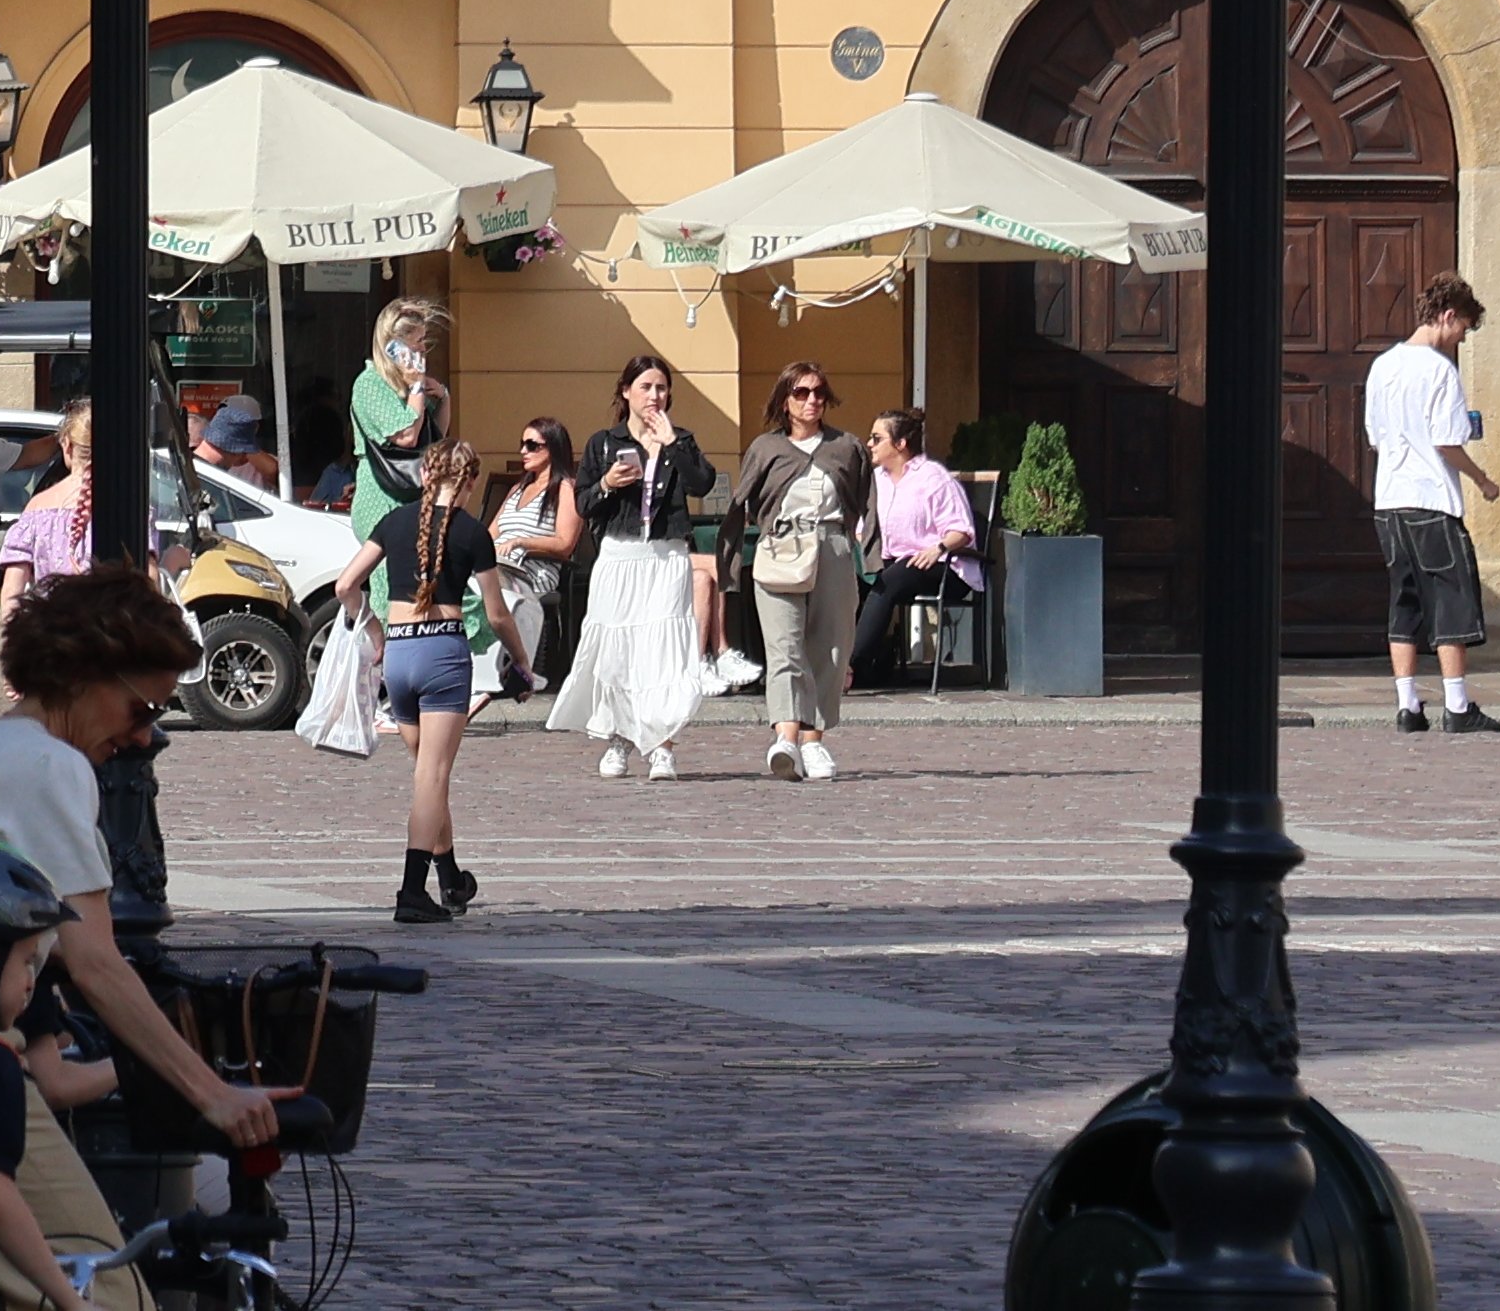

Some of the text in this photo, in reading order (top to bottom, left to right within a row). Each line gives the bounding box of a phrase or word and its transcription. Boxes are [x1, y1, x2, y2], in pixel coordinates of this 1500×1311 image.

[150, 230, 213, 257] eken
[285, 211, 438, 248] BULL PUB
[1143, 227, 1207, 257] BULL PUB
[386, 621, 457, 638] NIKE NIKE
